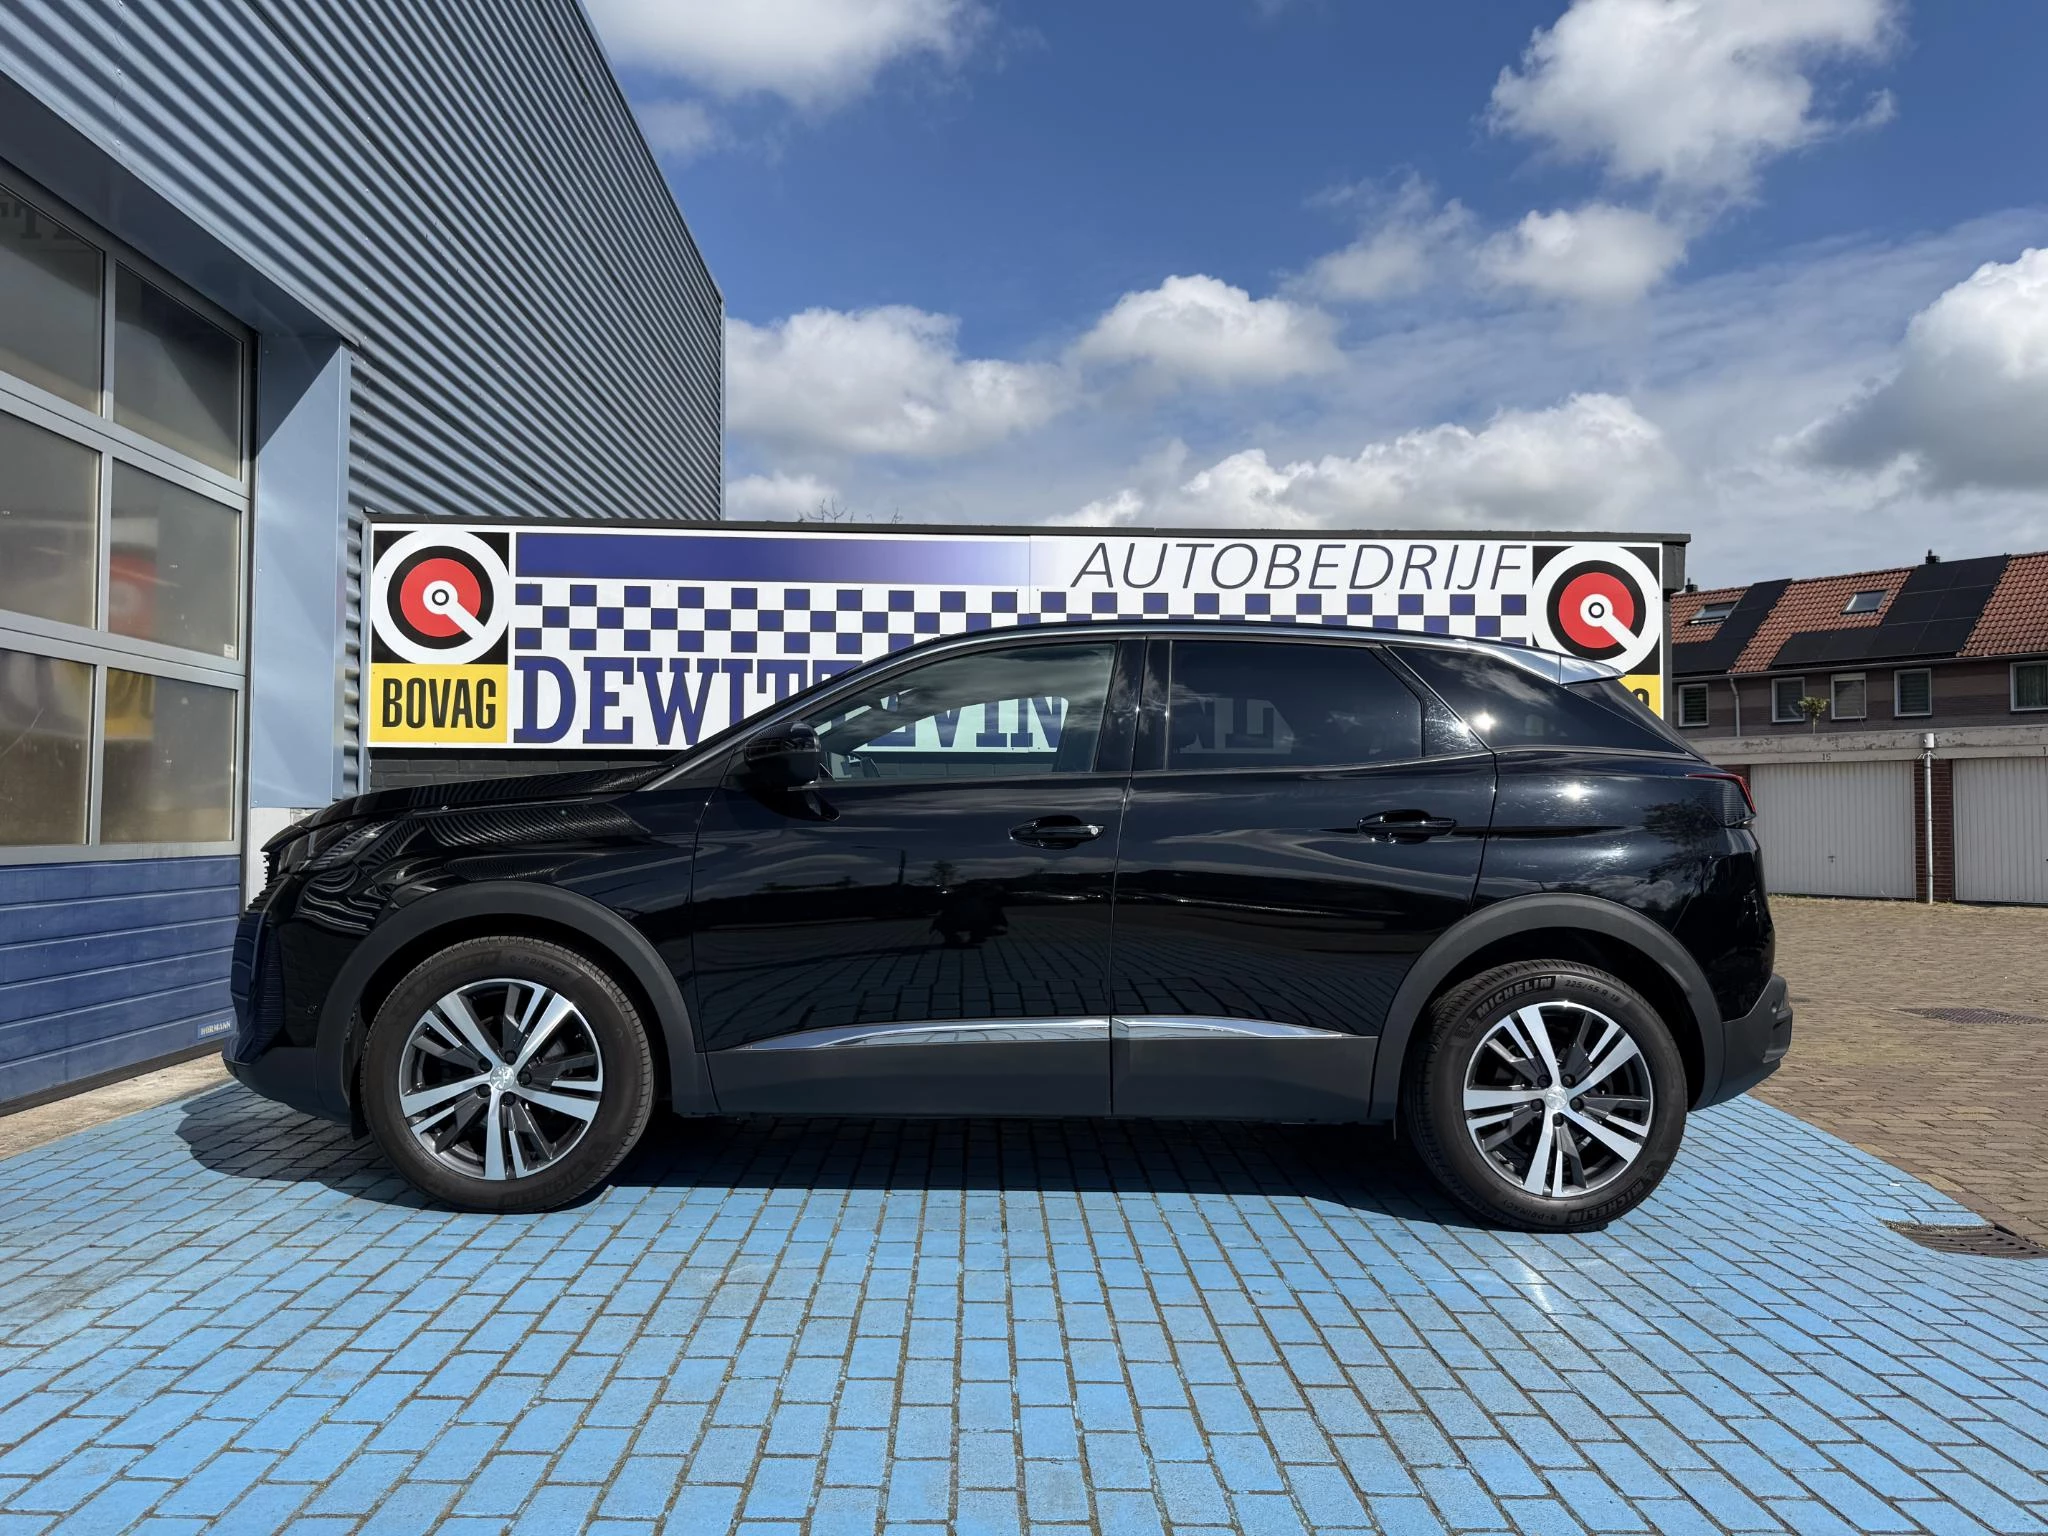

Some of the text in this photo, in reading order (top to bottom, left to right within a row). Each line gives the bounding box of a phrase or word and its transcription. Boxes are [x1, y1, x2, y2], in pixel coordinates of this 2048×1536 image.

[1070, 542, 1527, 590] AUTOBEDRIJF
[381, 676, 497, 730] BOVAG
[1477, 976, 1556, 1019] MICHELIN
